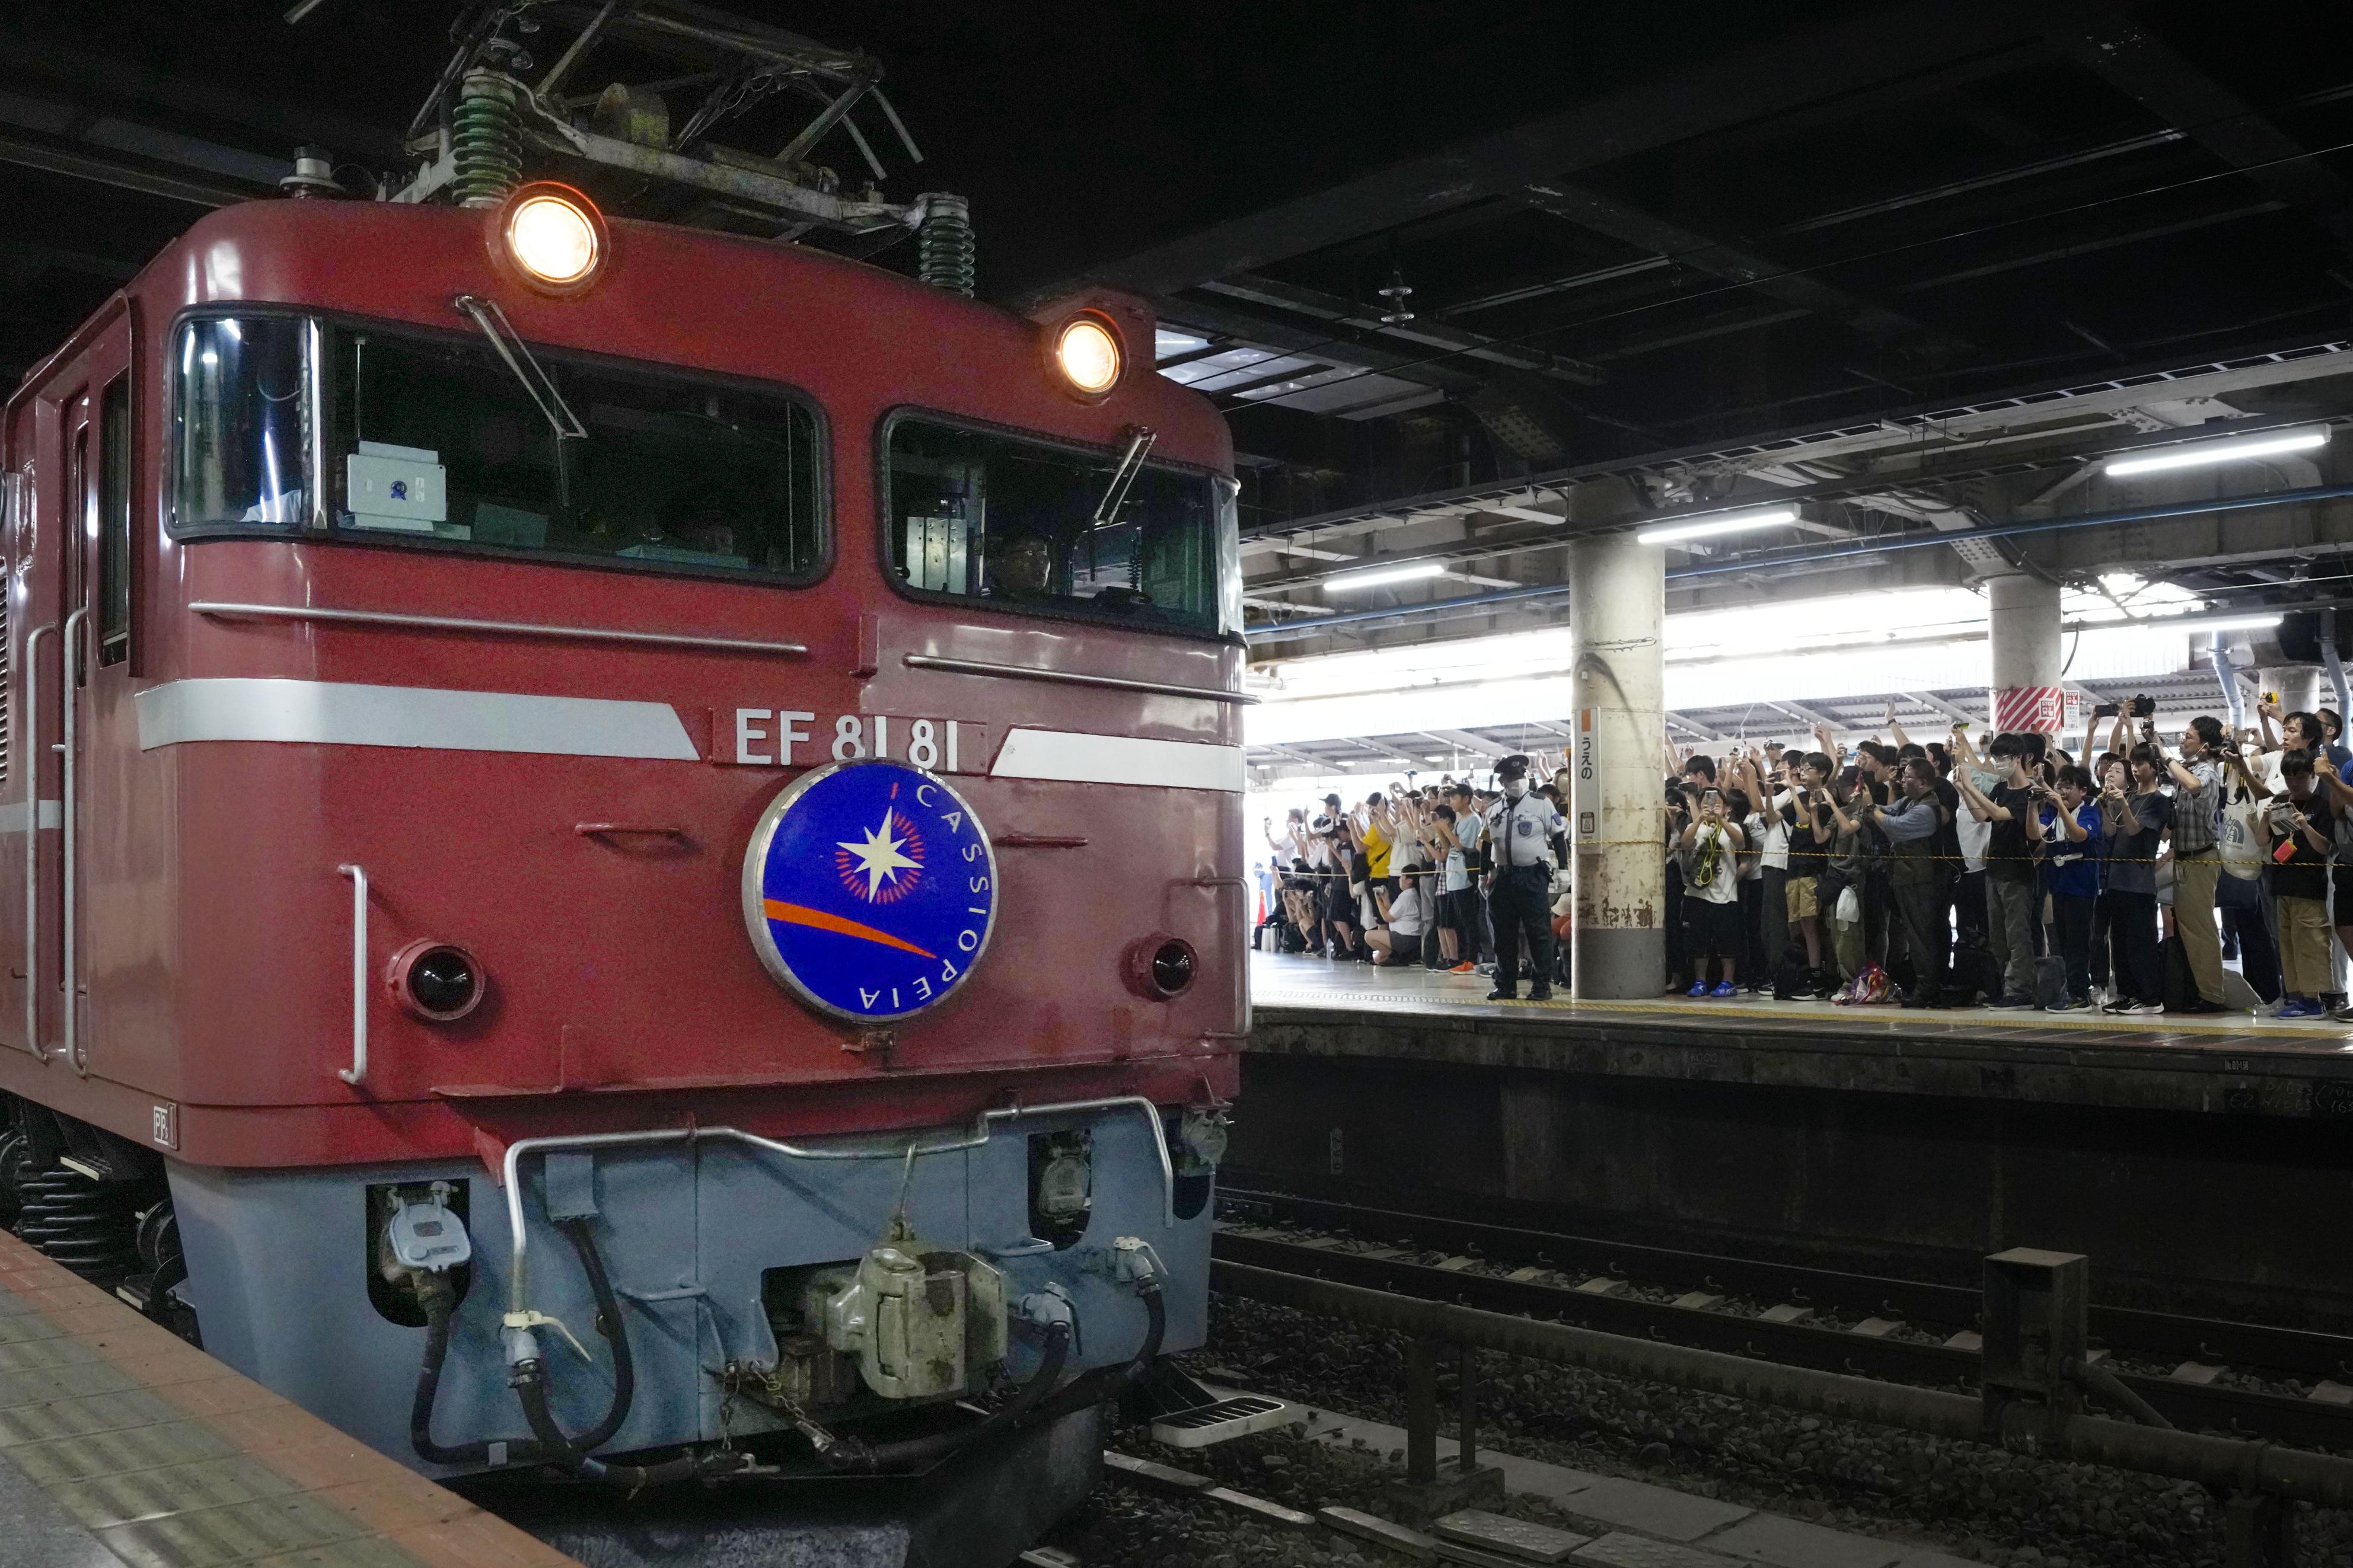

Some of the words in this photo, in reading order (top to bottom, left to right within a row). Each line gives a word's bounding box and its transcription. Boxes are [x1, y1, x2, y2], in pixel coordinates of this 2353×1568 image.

[736, 708, 815, 765] EF
[831, 714, 887, 759] 81
[908, 719, 958, 772] 81
[1581, 737, 1593, 780] うえの
[859, 784, 989, 1009] CASSIOPEIA
